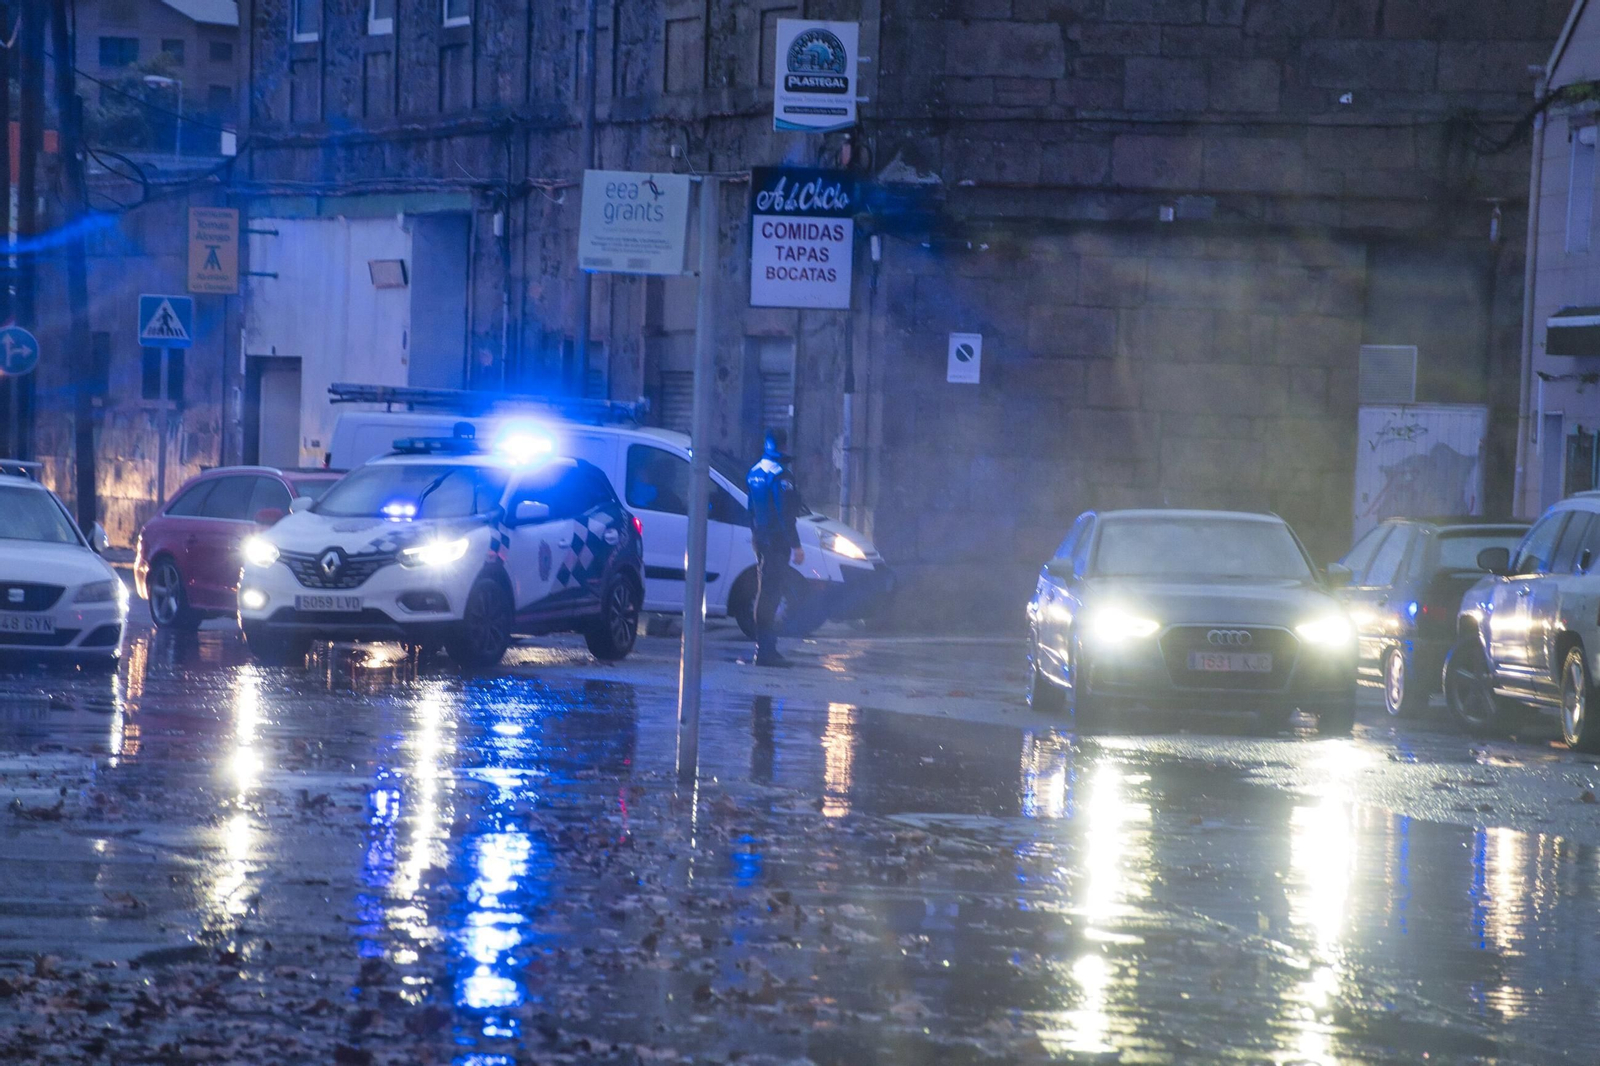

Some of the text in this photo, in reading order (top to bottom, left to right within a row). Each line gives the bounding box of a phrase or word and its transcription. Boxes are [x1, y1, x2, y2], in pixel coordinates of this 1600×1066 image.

[788, 76, 846, 89] PLASTEGAL
[605, 182, 639, 200] eea
[603, 202, 664, 225] grants
[761, 222, 844, 242] COMIDAS
[775, 245, 830, 262] TAPAS
[765, 266, 837, 282] BOCATAS
[303, 596, 333, 609] 5059
